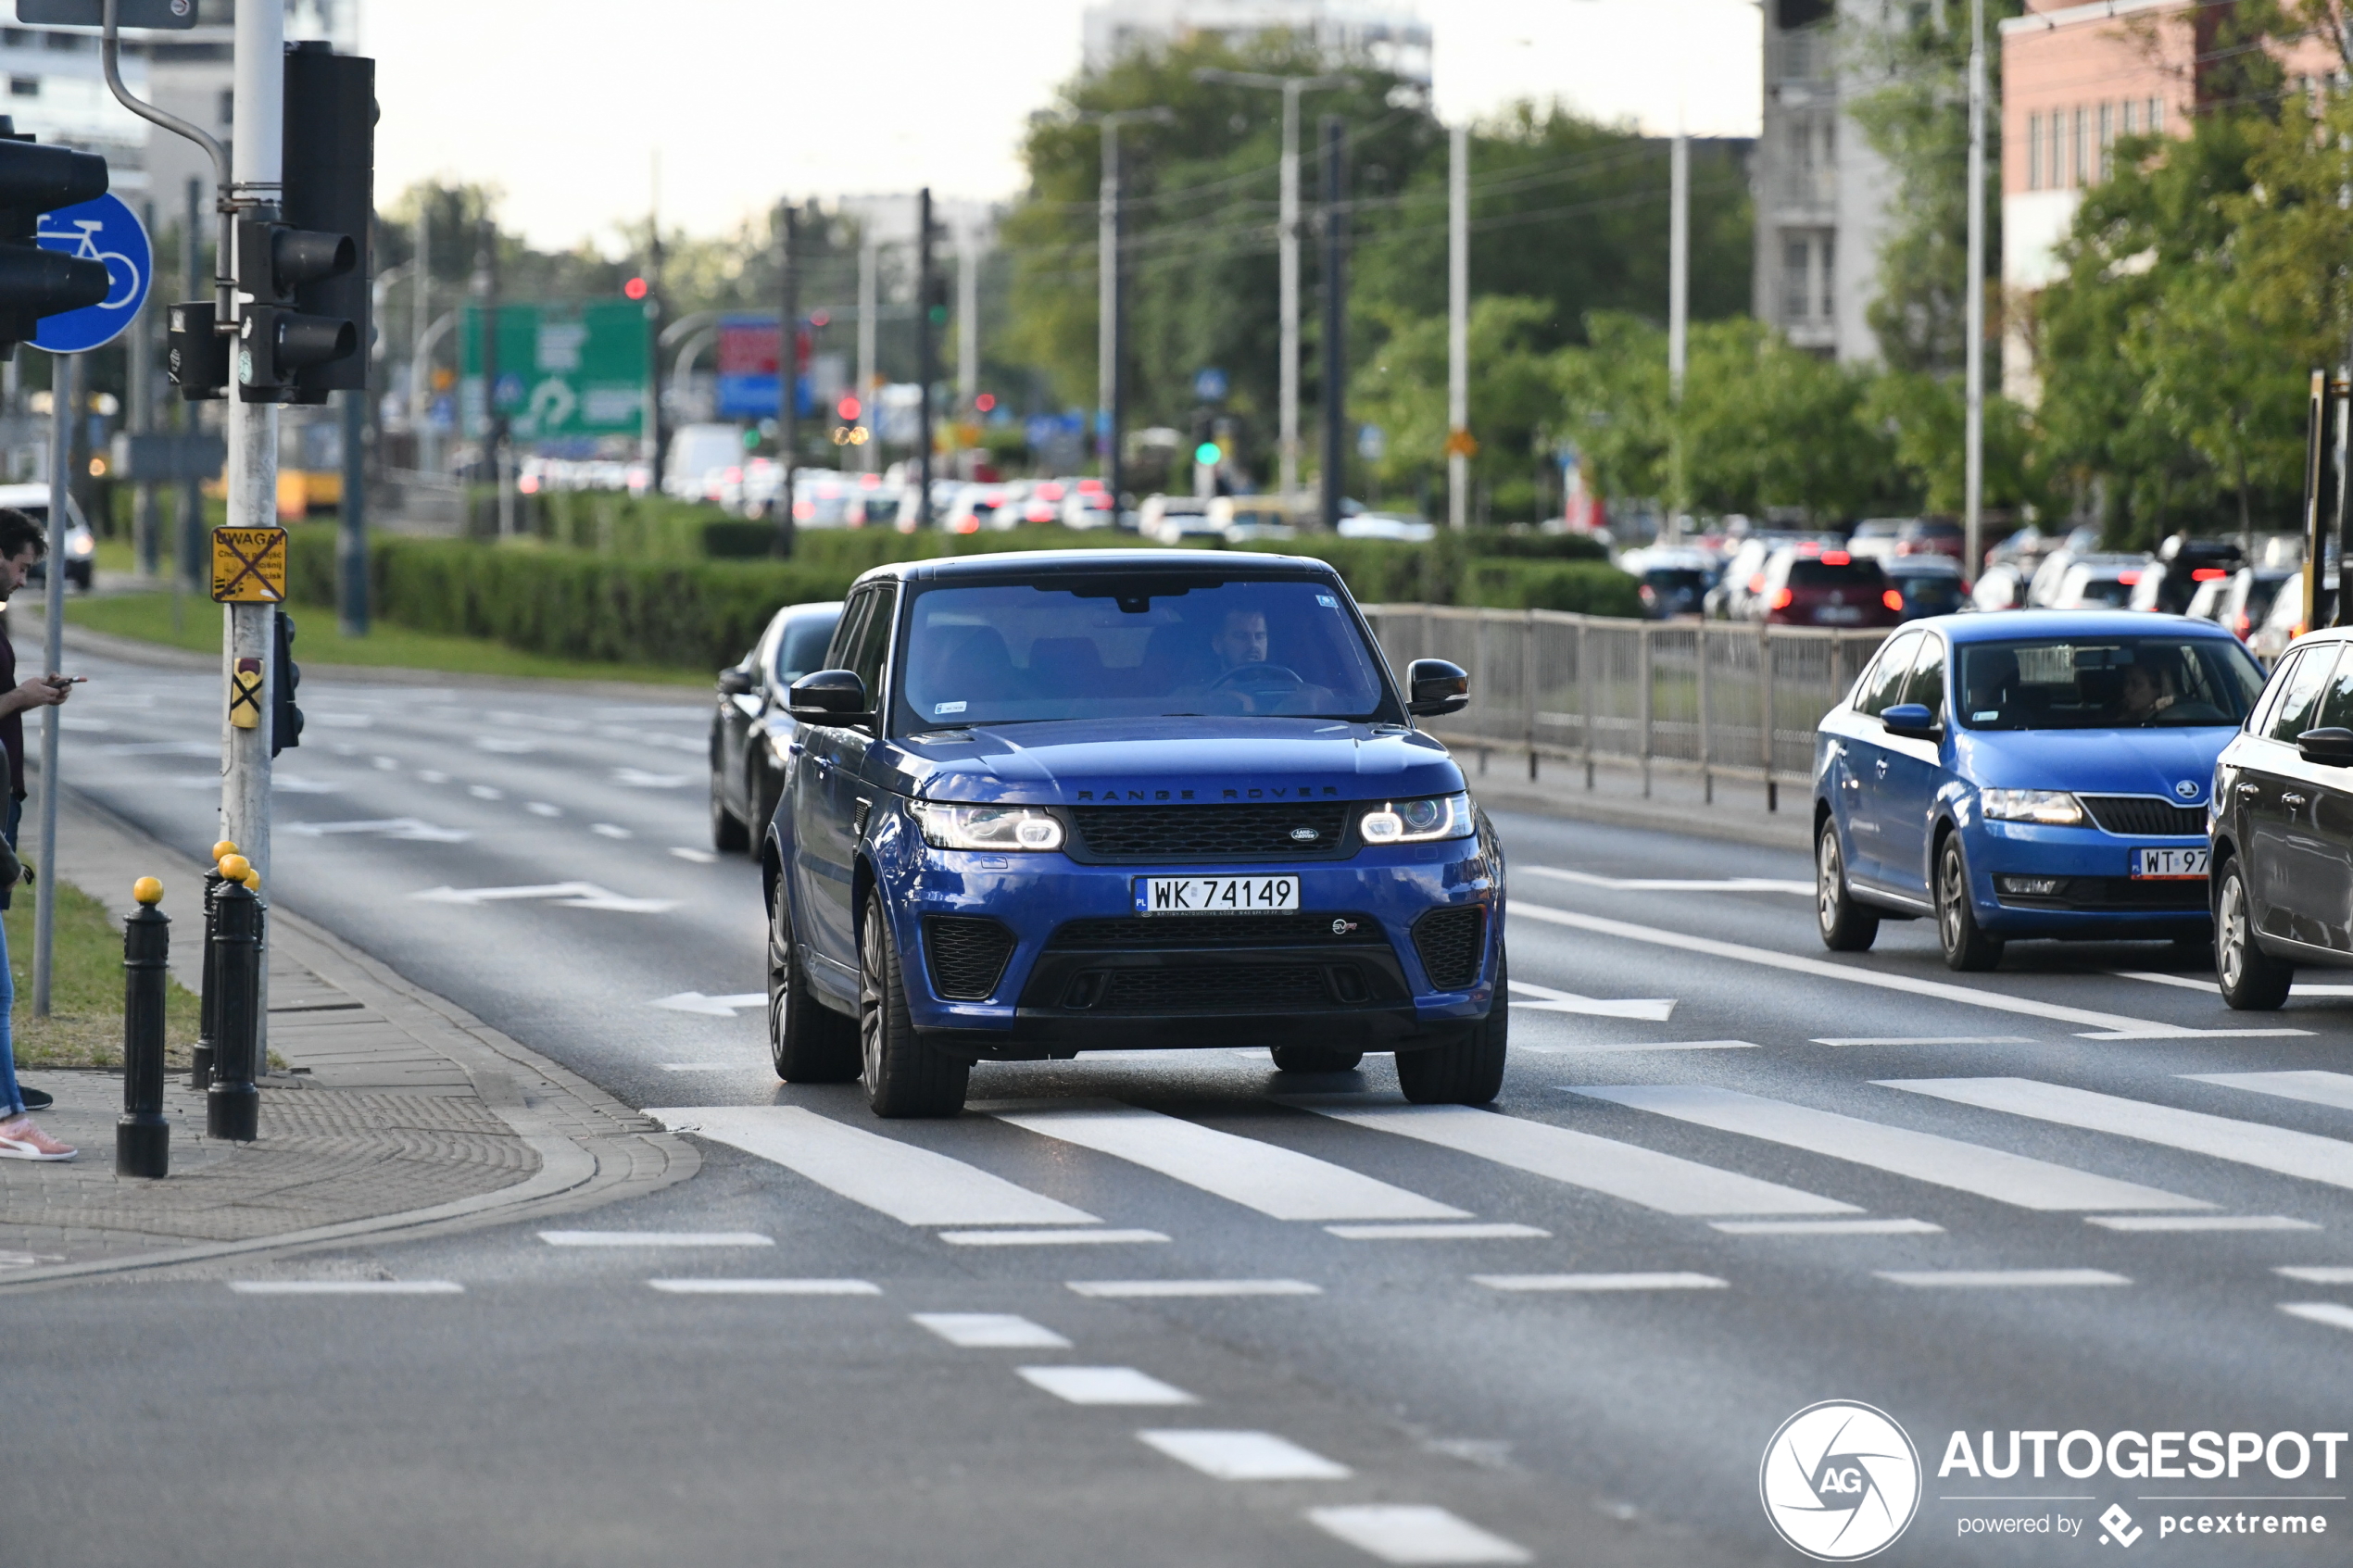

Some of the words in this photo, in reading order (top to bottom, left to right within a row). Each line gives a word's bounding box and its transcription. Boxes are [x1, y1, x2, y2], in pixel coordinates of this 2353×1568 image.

[1077, 790, 1195, 800] RANGE
[1223, 786, 1338, 798] ROVER
[2146, 851, 2174, 872] WT
[1136, 898, 1146, 907] PL
[1155, 881, 1190, 908] WK
[1203, 880, 1291, 908] 74149
